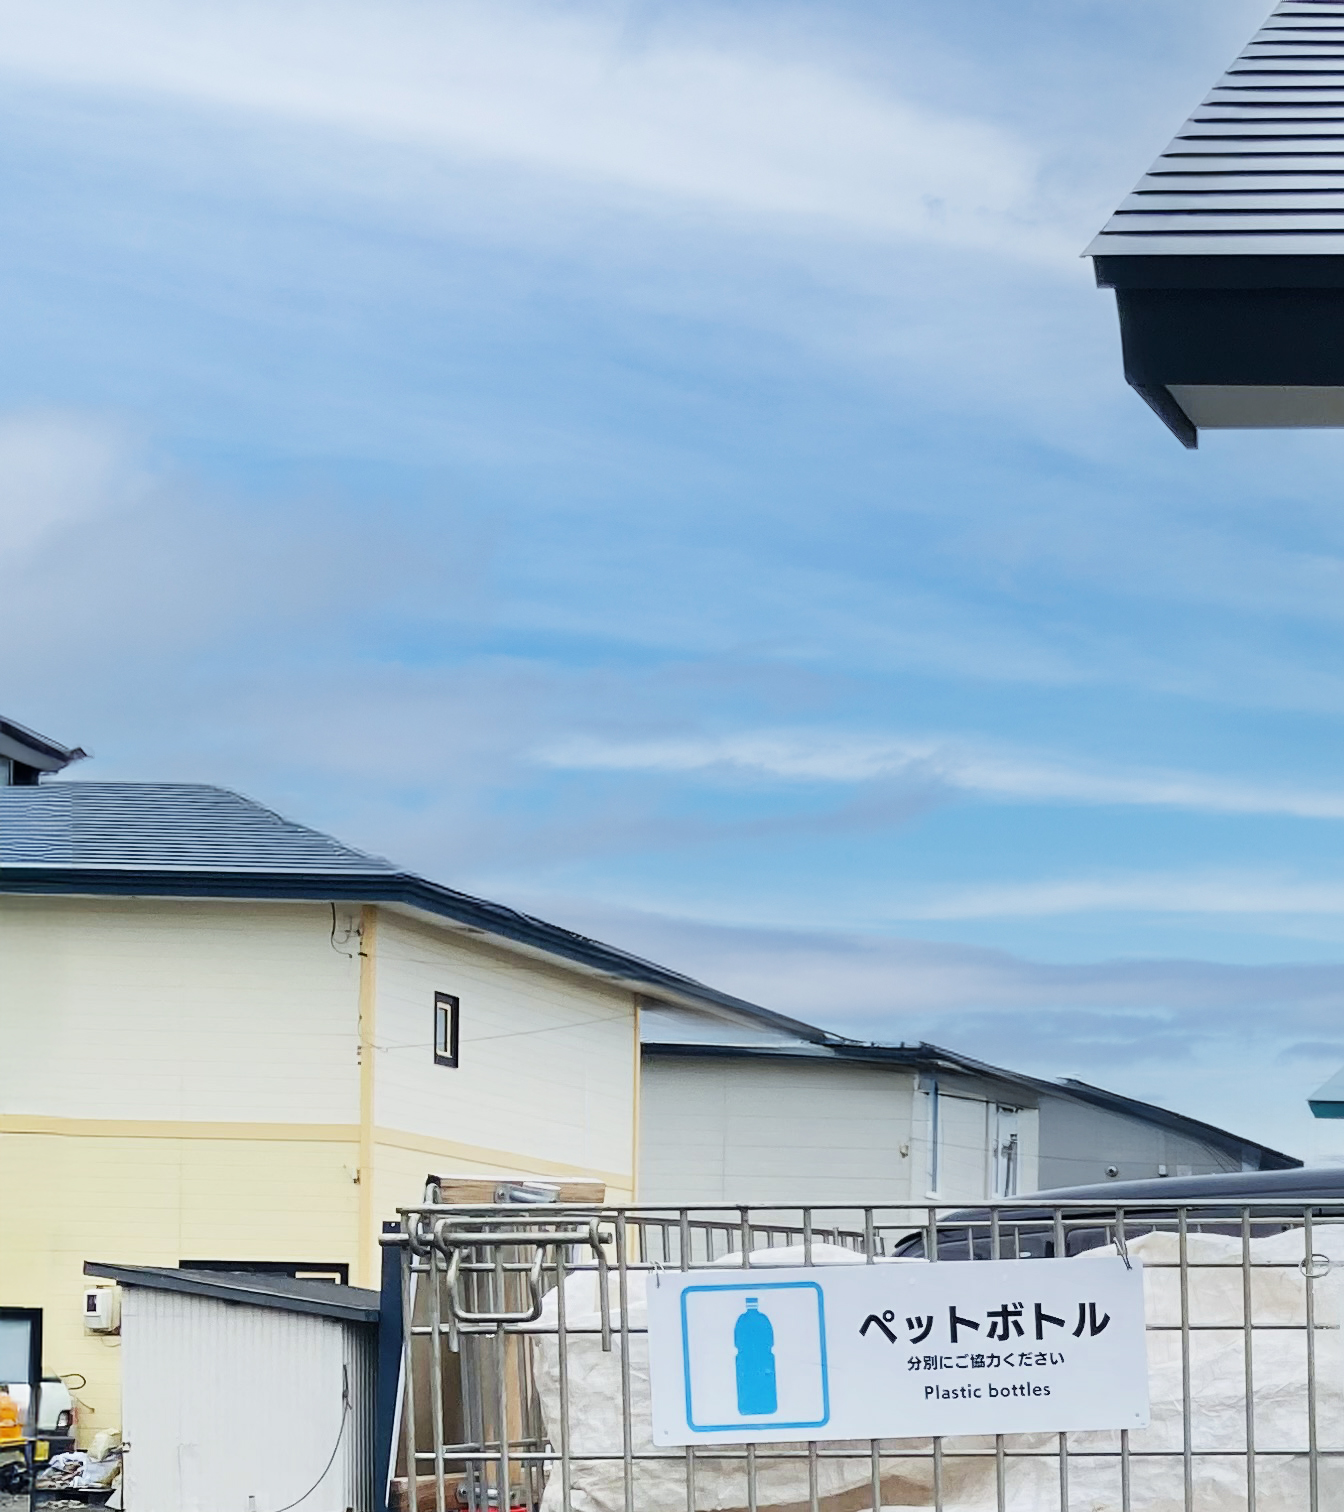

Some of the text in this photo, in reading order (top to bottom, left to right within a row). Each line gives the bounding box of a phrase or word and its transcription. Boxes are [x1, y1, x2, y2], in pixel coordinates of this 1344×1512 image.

[859, 1302, 1111, 1344] ペットボトル
[906, 1352, 1066, 1371] 分別にご協力ください
[924, 1381, 1051, 1400] Plastic bottles
